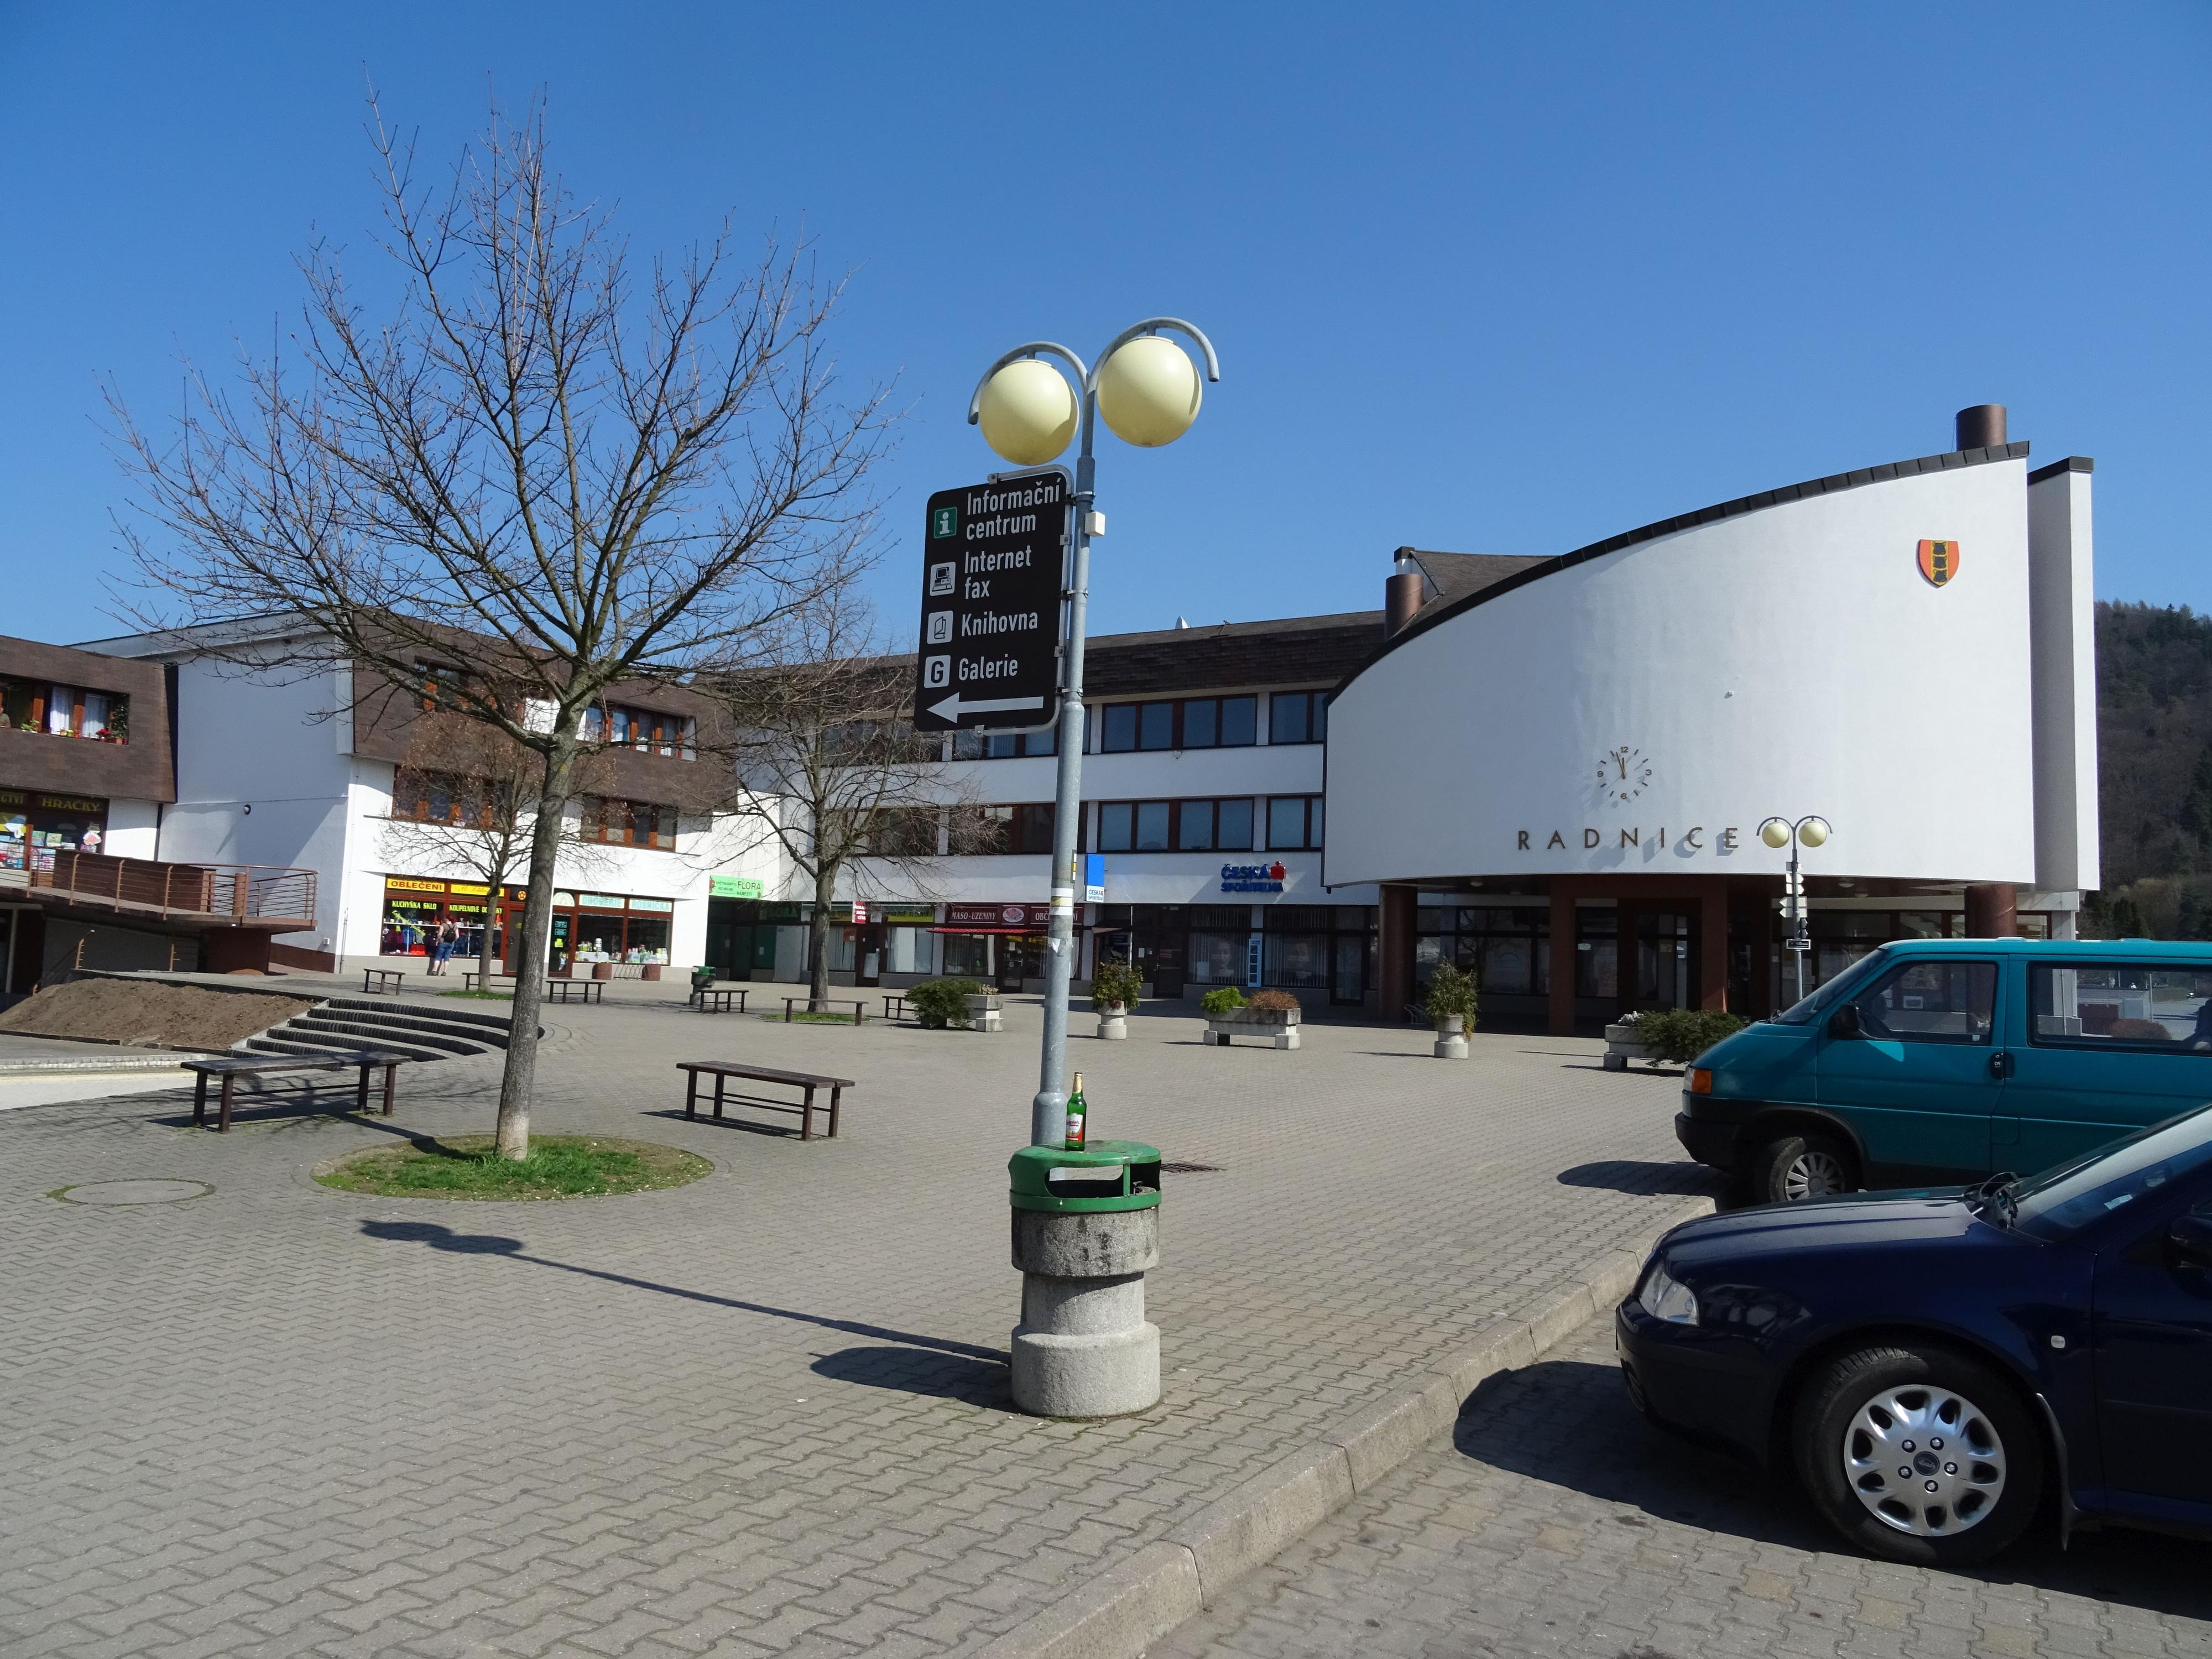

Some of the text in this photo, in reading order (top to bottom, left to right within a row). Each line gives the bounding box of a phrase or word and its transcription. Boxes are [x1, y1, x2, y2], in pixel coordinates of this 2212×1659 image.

[967, 477, 1061, 516] Informační
[966, 513, 1036, 541] centrum
[964, 545, 1032, 574] Internet
[964, 576, 990, 600] fax
[961, 611, 1039, 637] Knihovna
[930, 653, 1019, 684] G Galerie
[1620, 792, 1627, 800] 6
[1517, 826, 1739, 851] RADNICE
[1221, 863, 1270, 879] ČESKÁ
[737, 880, 761, 891] FLORA
[971, 912, 997, 920] UZENINY
